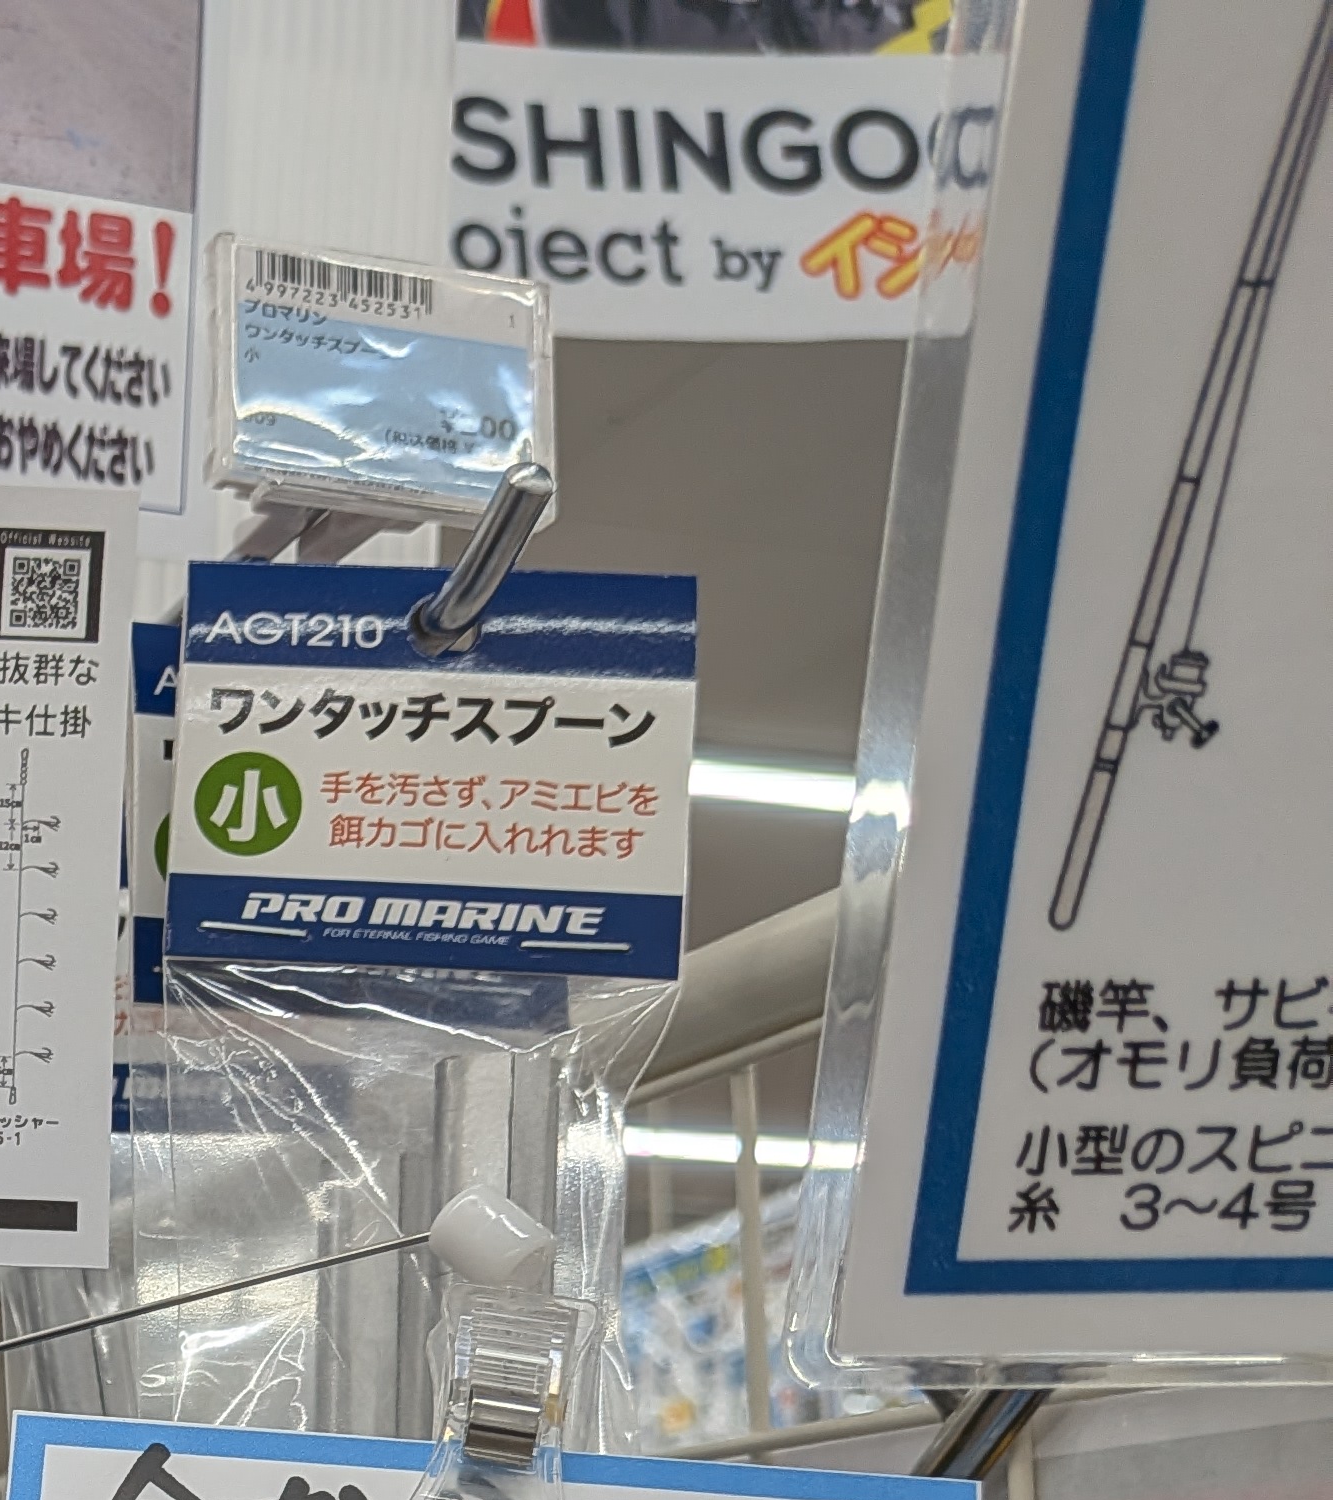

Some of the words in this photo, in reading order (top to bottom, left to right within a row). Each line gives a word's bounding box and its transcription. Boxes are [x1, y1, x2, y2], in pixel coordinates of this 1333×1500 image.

[713, 238, 782, 291] by
[204, 612, 384, 650] AGT210
[207, 686, 656, 749] ワンタッチスプーン
[210, 769, 287, 842] 小
[319, 770, 660, 817] 手を汚さず、アミエビを
[328, 814, 644, 859] 餌カゴに入れれます
[241, 890, 362, 924] PRO
[369, 895, 607, 937] MARINE
[1215, 976, 1333, 1031] サビ
[1008, 1182, 1060, 1233] 糸
